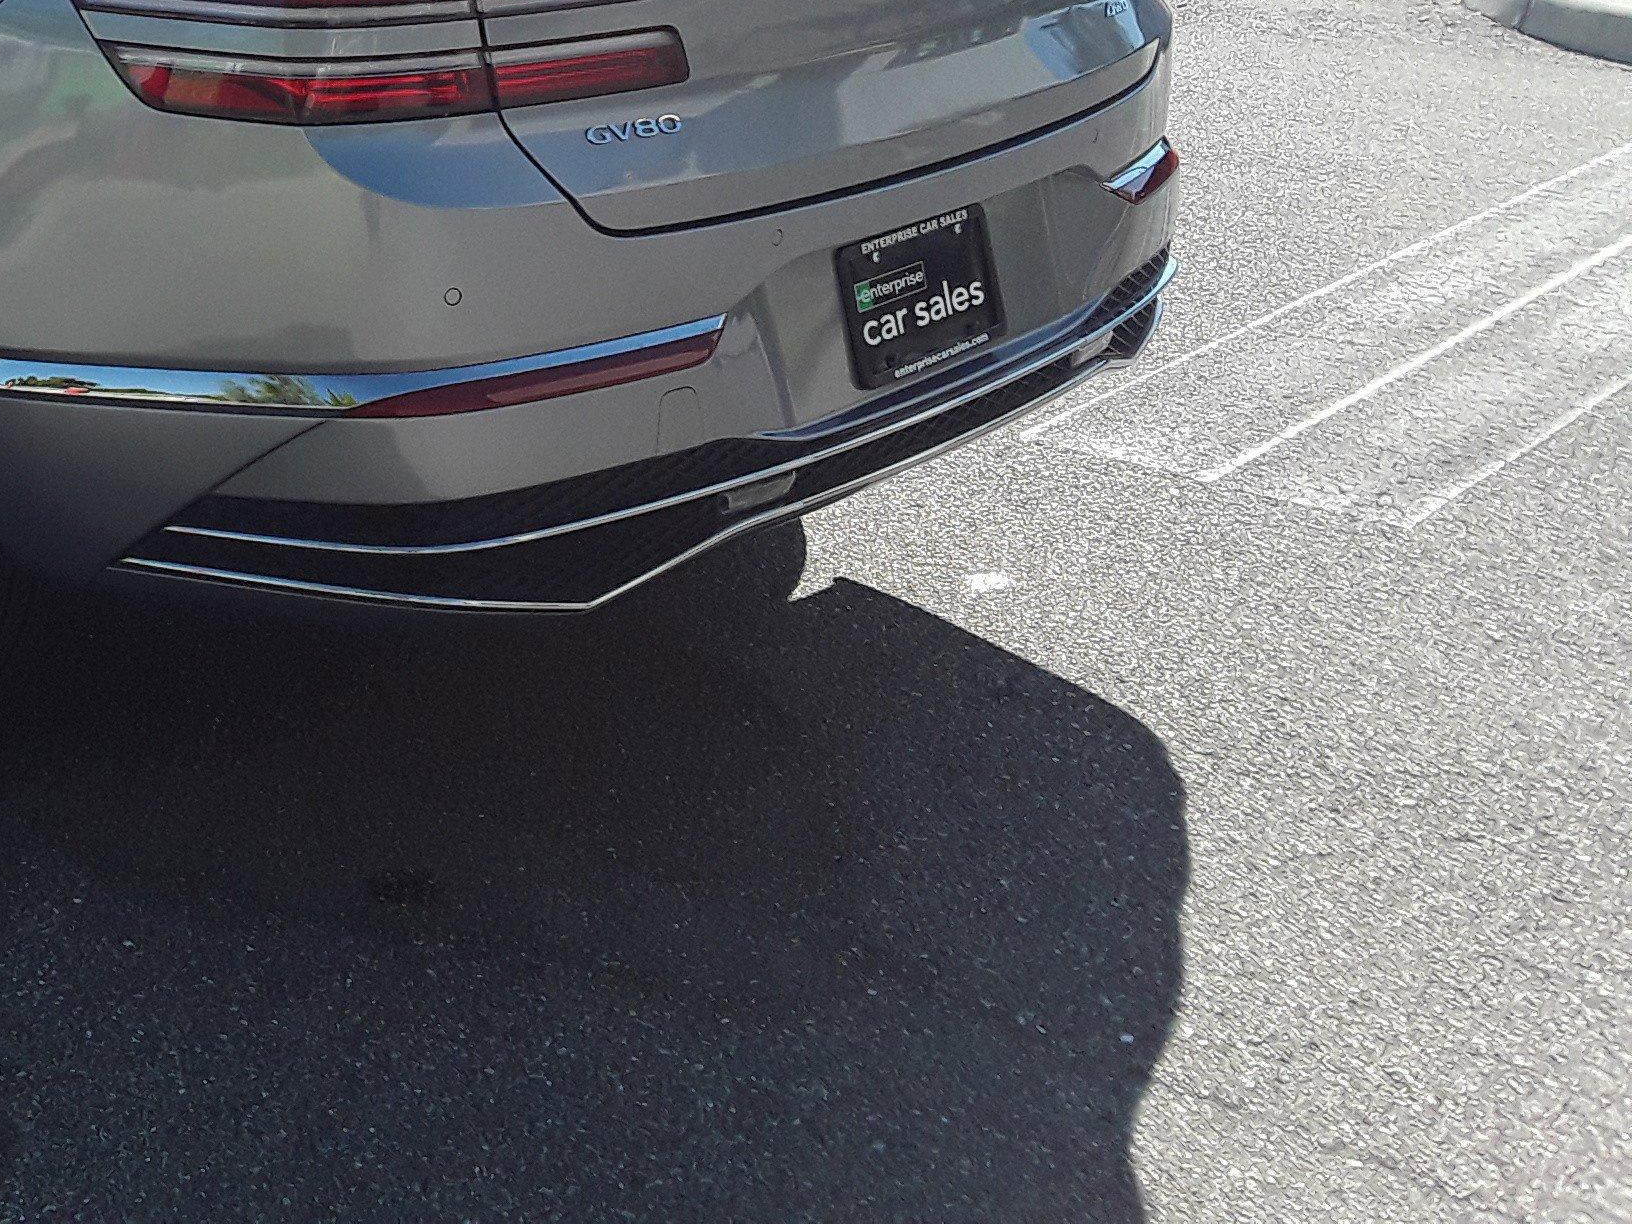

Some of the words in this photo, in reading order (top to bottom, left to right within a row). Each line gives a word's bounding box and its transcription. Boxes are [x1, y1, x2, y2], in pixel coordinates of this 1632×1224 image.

[585, 114, 682, 145] GV80
[860, 225, 918, 254] ENTERPRISE
[919, 219, 939, 235] CAR
[939, 209, 968, 228] SALES
[860, 270, 924, 301] enterprise
[863, 307, 908, 346] car
[914, 279, 985, 327] sales
[894, 332, 990, 378] enterprisecarsales.com
